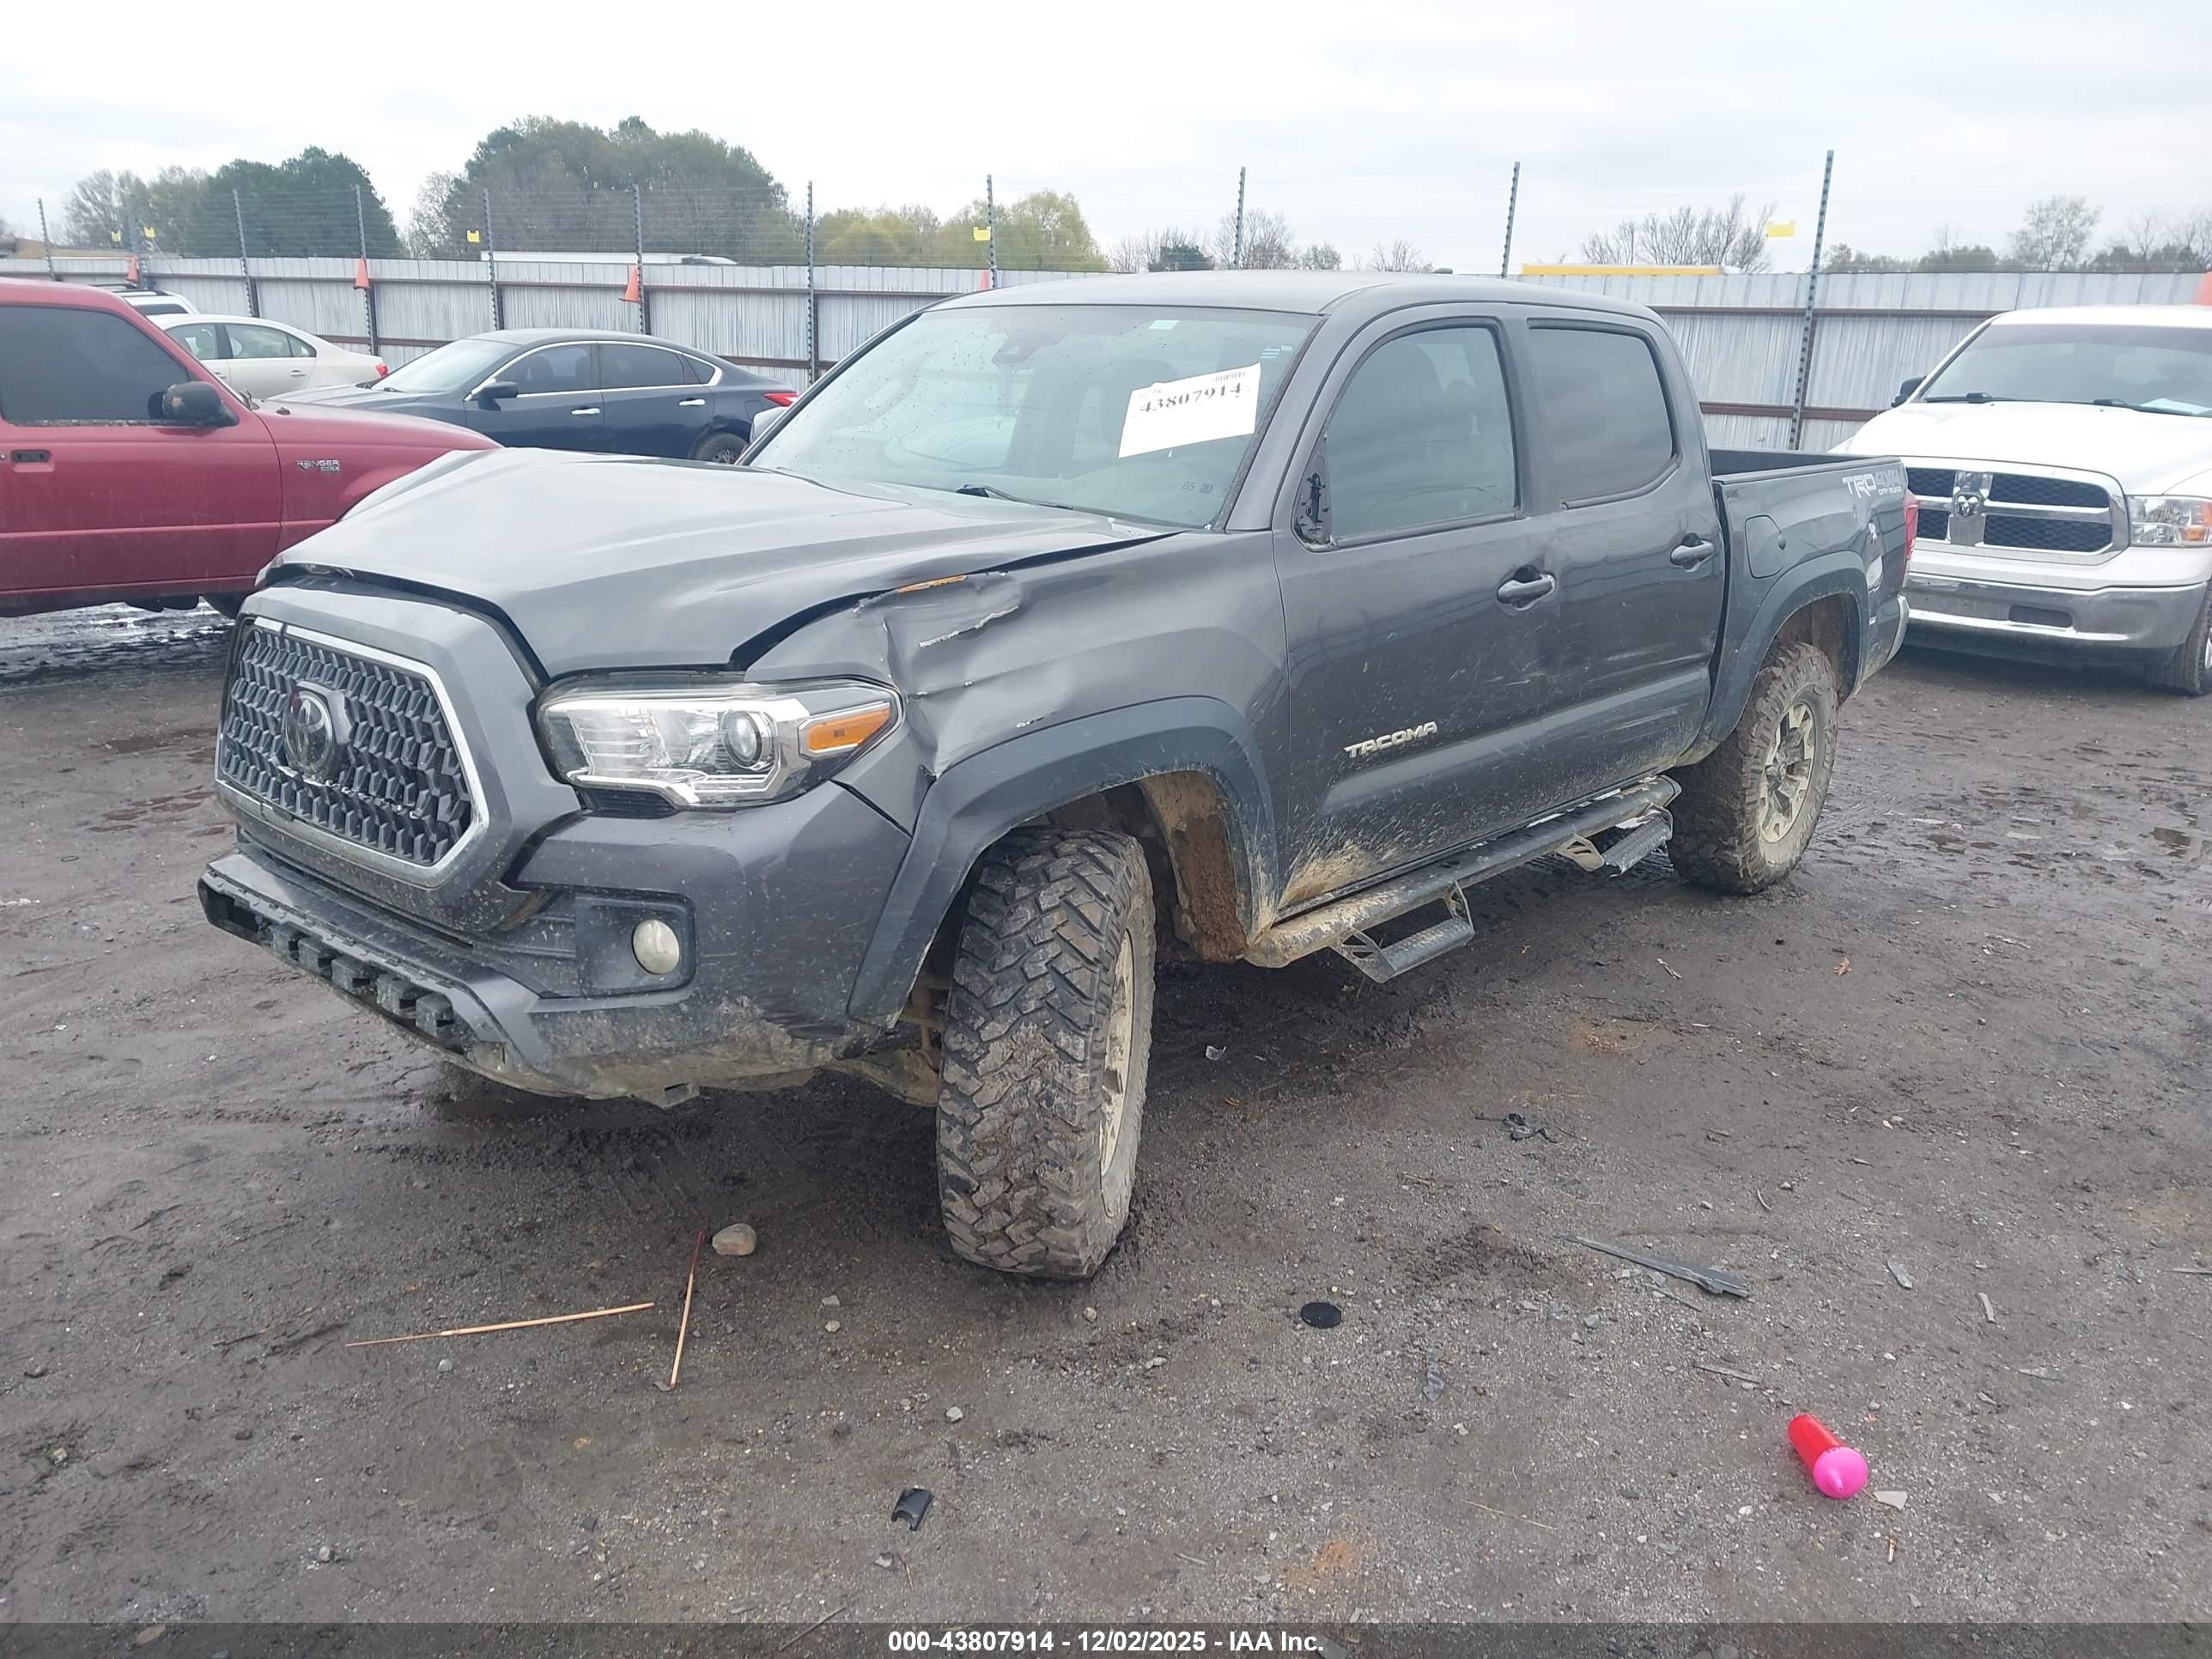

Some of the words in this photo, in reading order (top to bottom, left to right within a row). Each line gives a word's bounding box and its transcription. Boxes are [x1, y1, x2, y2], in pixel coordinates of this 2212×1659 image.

[1139, 382, 1243, 412] 43807914
[1842, 473, 1876, 498] TRD
[1343, 720, 1438, 758] TACOMA
